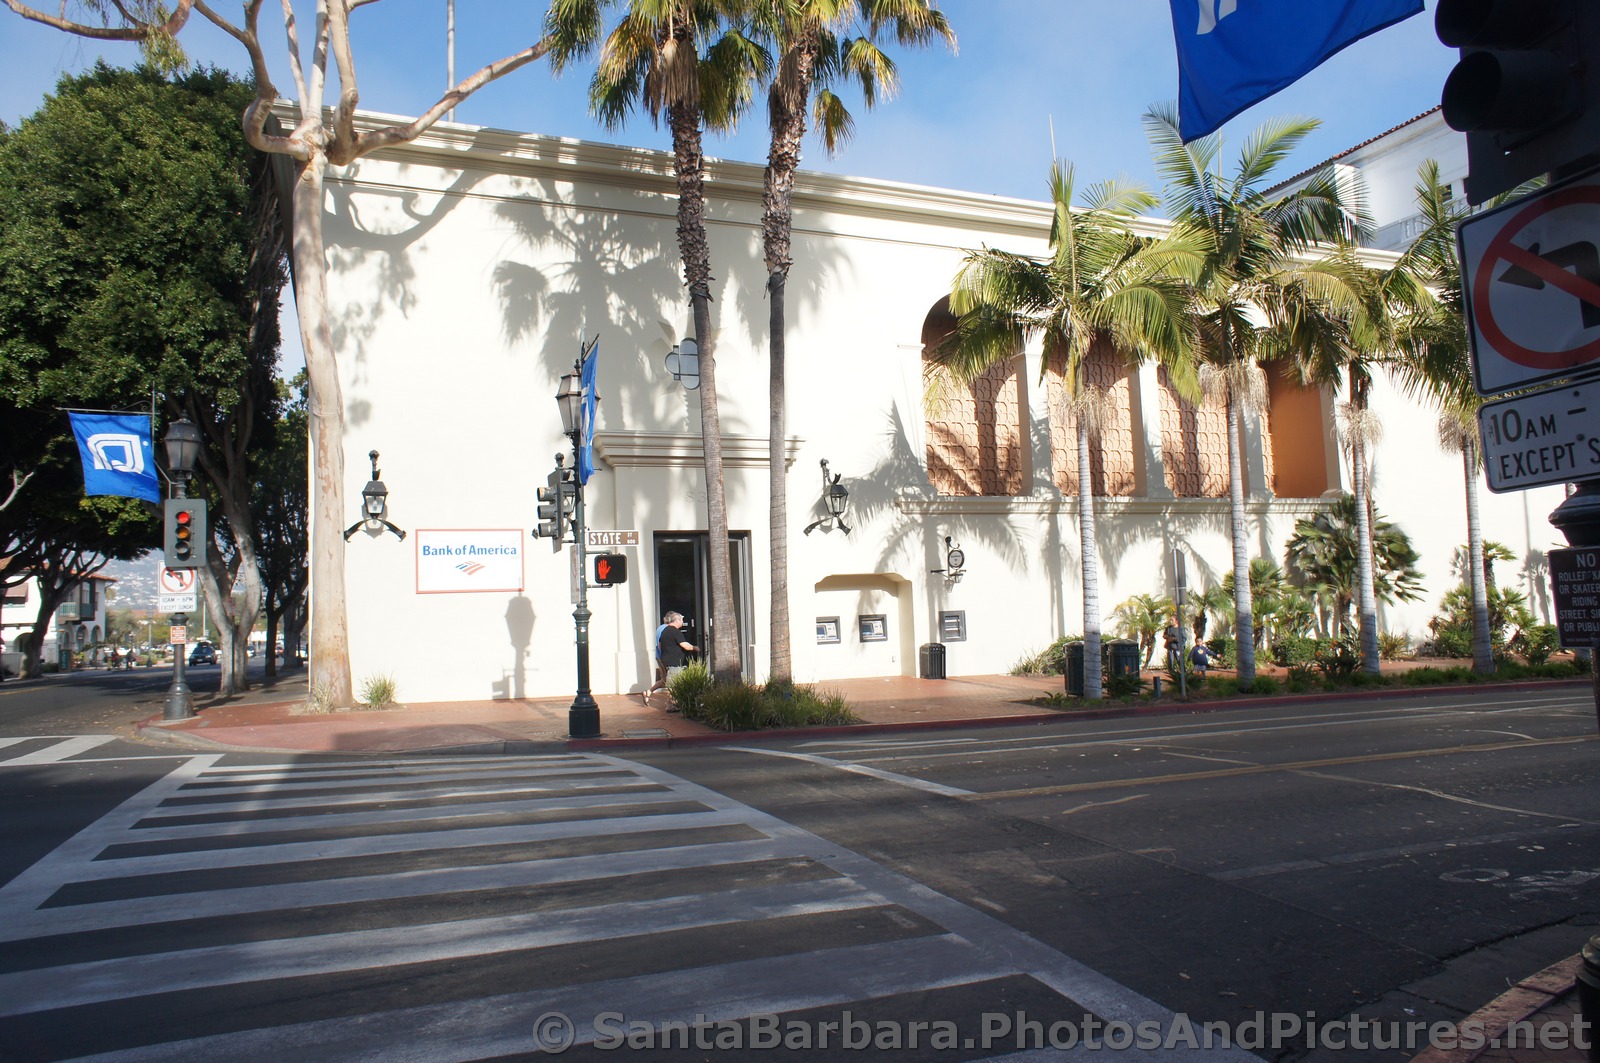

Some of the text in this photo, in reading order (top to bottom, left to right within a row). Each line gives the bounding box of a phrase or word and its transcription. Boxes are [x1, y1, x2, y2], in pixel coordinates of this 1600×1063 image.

[1500, 442, 1576, 480] EXCEPT
[590, 532, 621, 545] STATE
[422, 545, 517, 556] Bank of America
[1576, 553, 1596, 568] NO
[1559, 585, 1570, 595] OR
[1572, 597, 1598, 607] RIDING
[1564, 622, 1575, 632] OR
